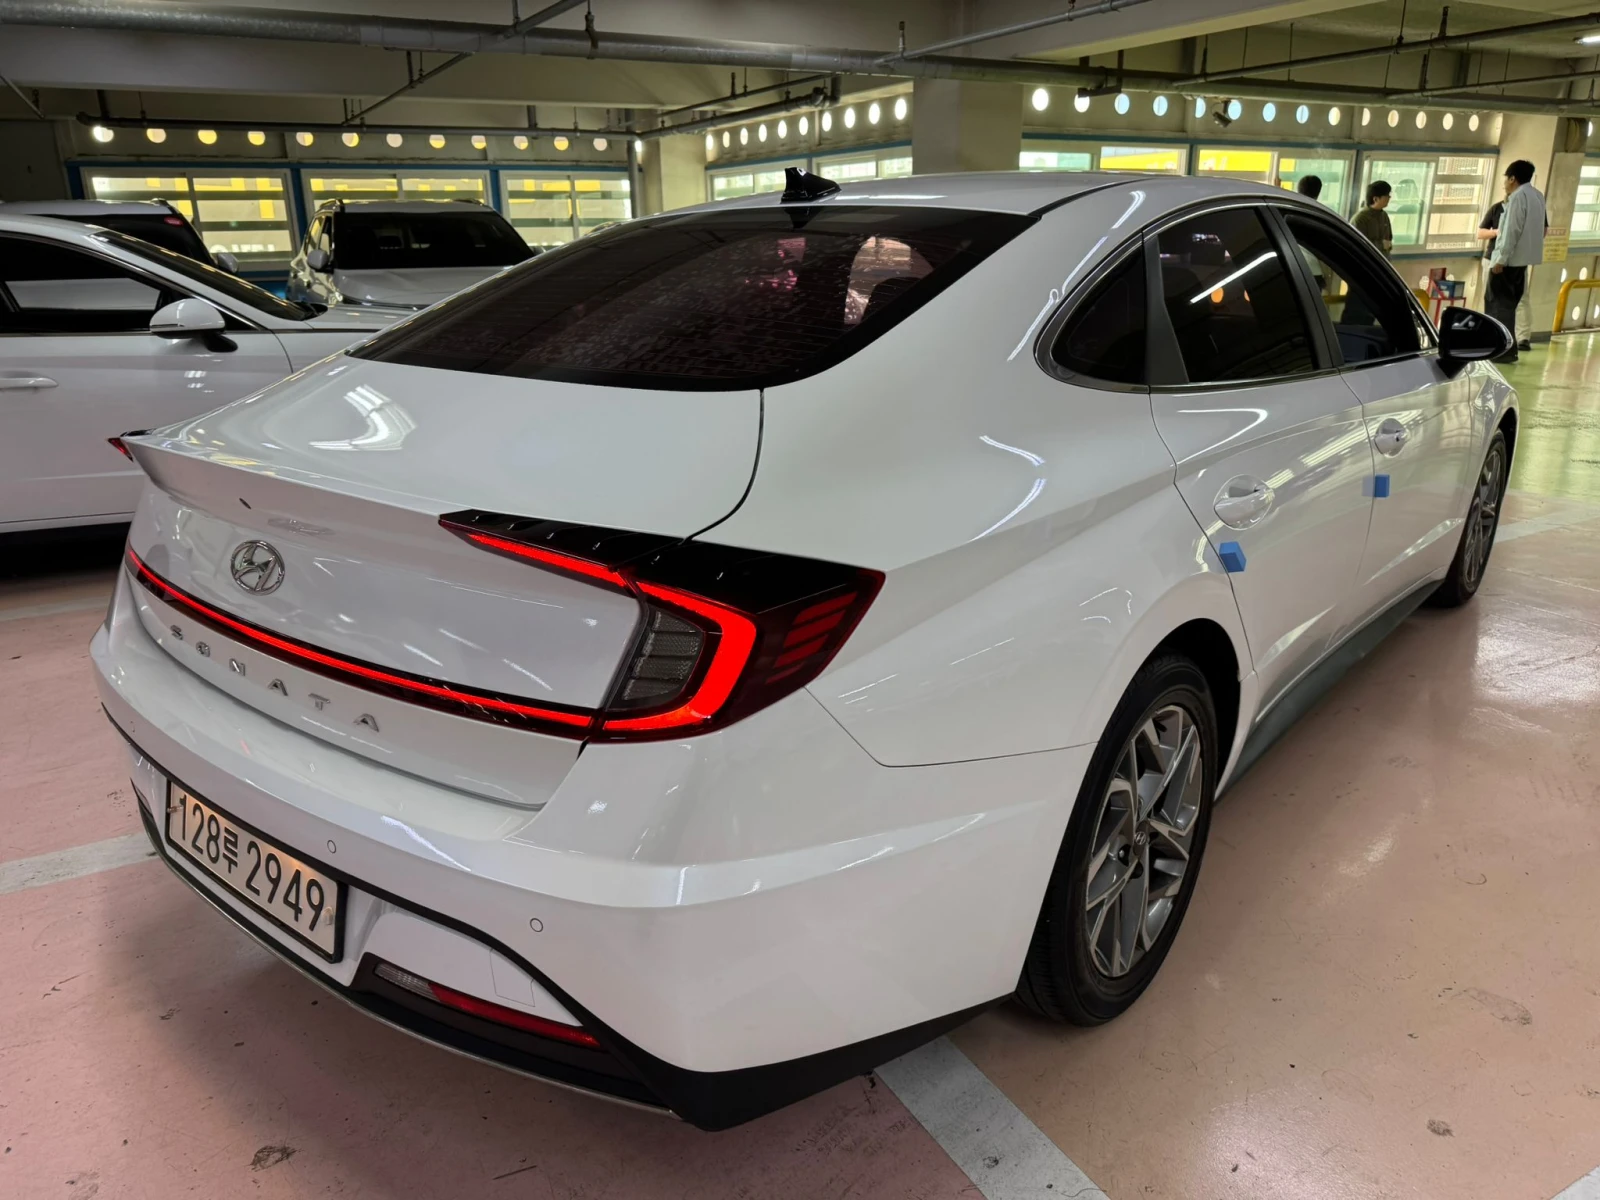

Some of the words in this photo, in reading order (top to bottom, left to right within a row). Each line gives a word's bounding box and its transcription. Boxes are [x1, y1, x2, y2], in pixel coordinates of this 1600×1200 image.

[170, 625, 380, 733] SONATA
[179, 794, 239, 874] 128루
[245, 840, 325, 932] 2949
